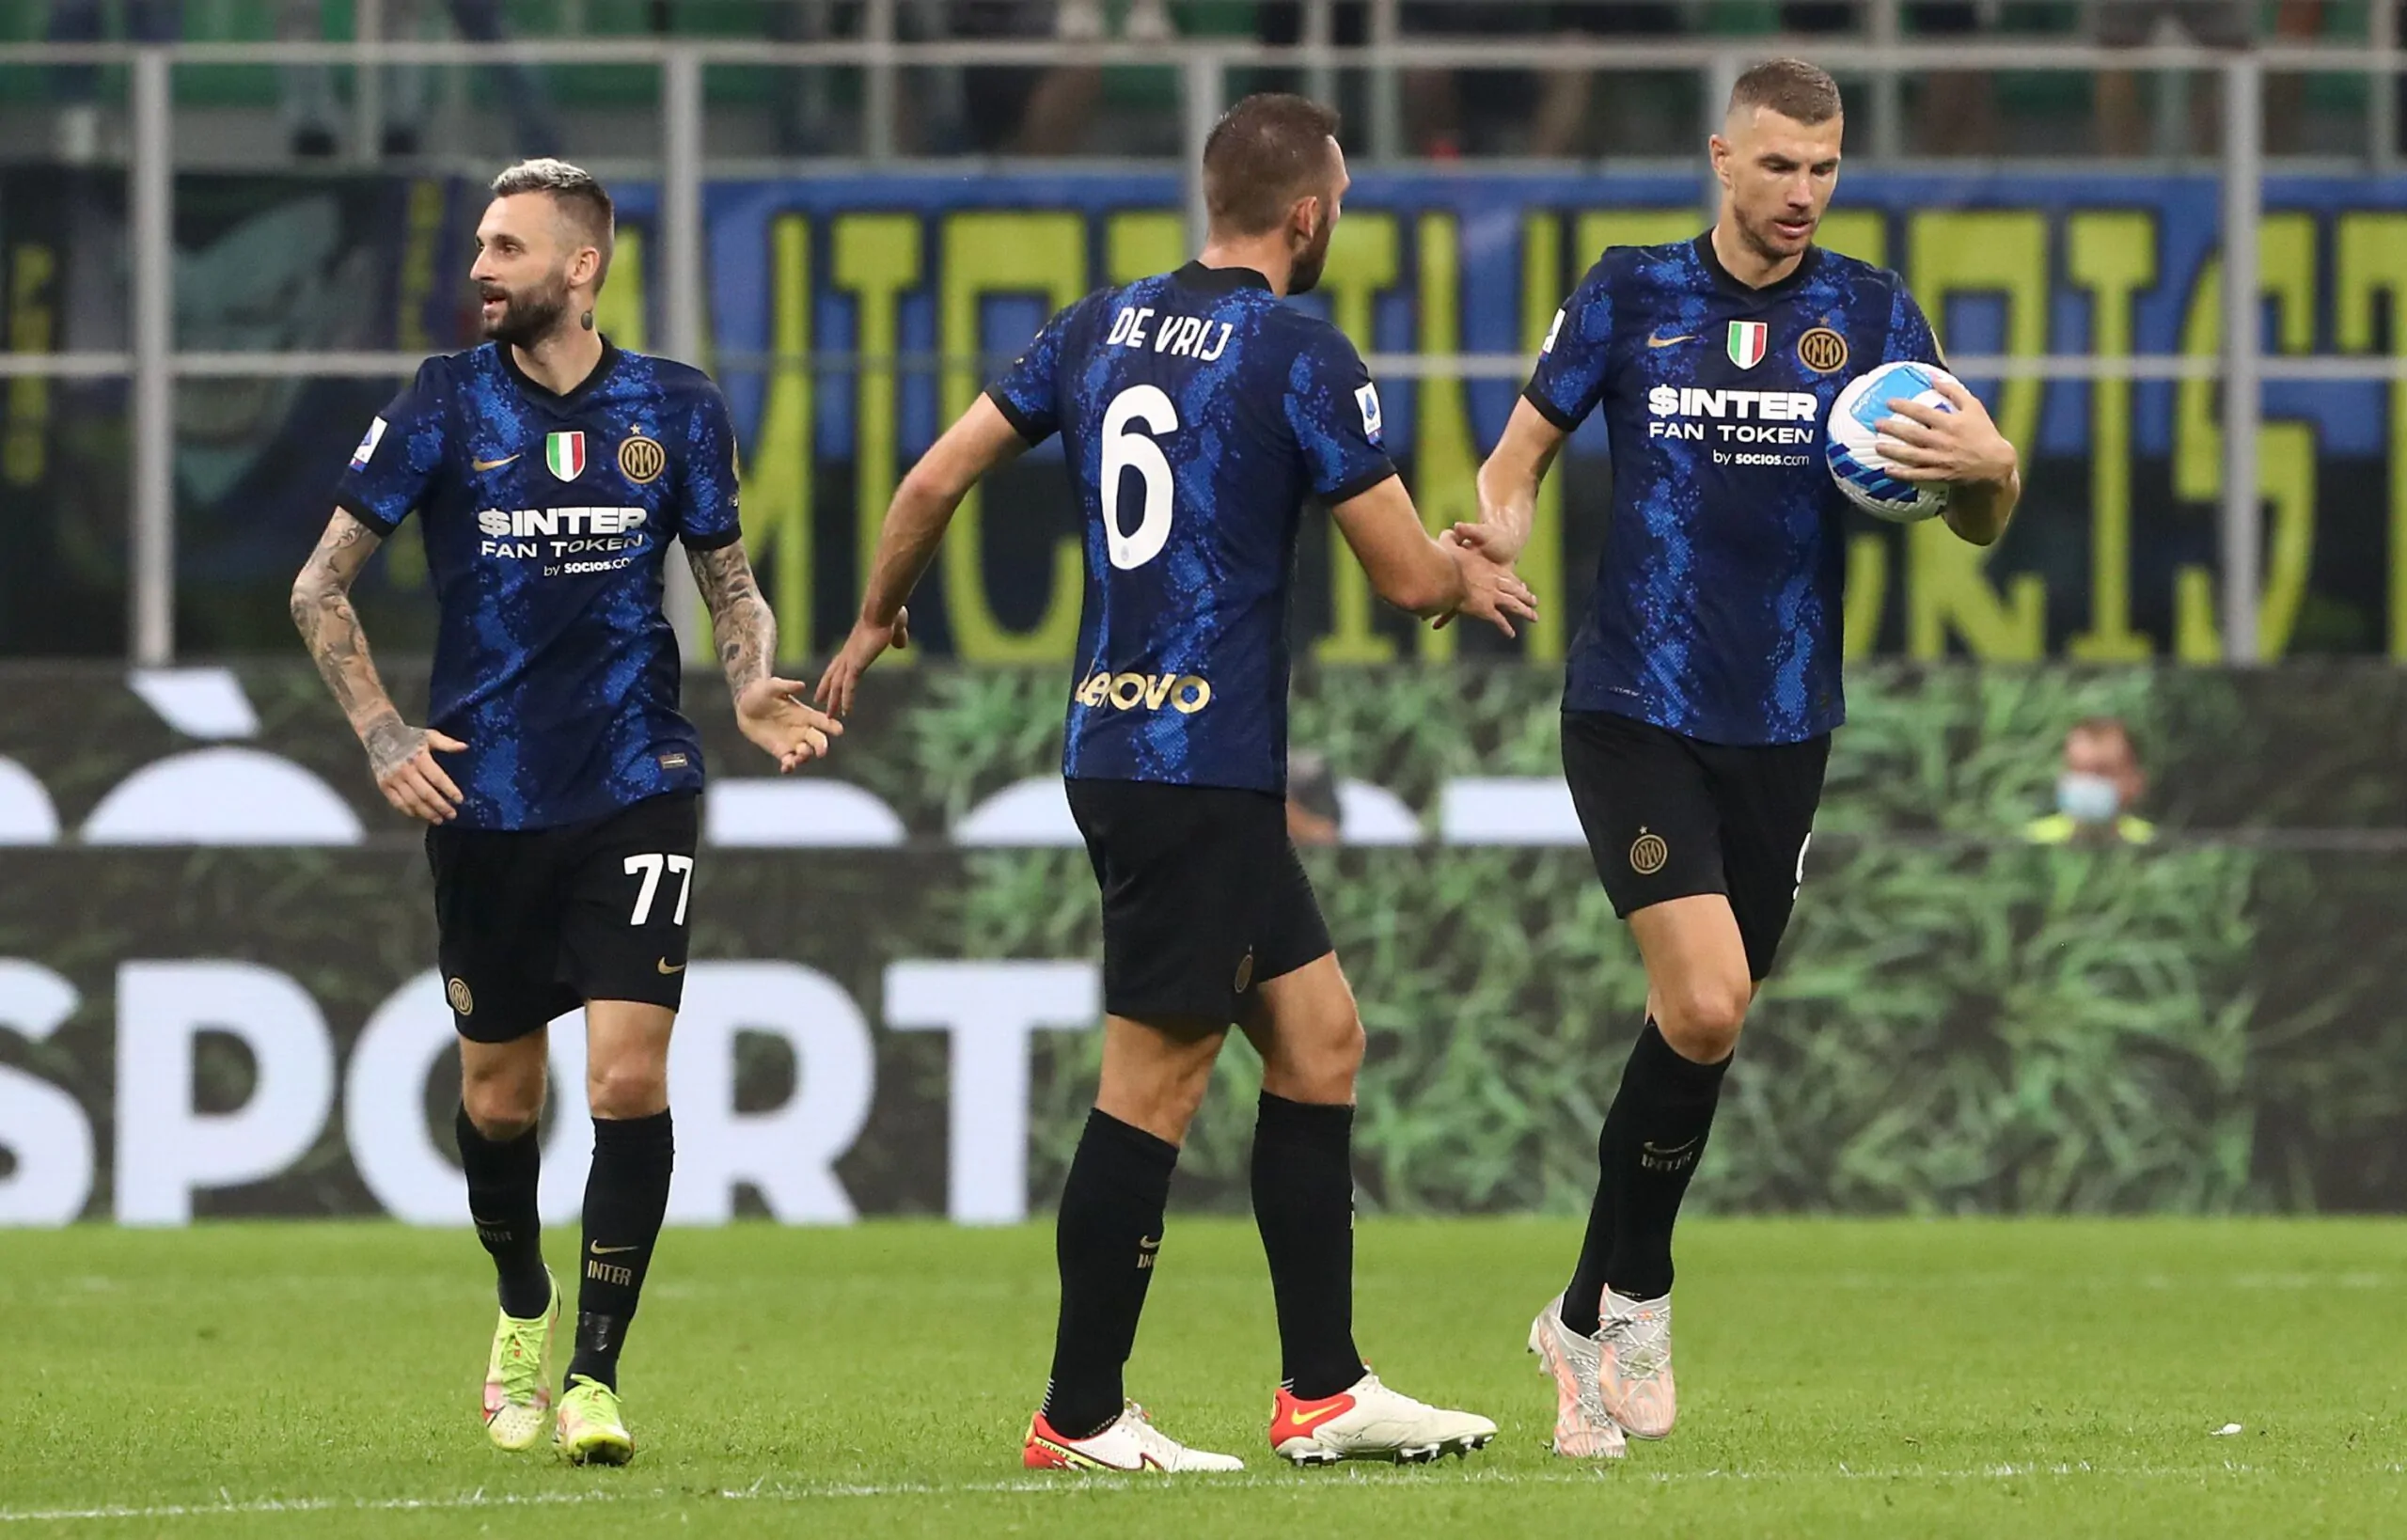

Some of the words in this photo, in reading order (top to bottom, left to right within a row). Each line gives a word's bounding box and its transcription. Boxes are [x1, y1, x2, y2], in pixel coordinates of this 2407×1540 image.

[1107, 307, 1154, 348] DE
[1156, 317, 1234, 362] VRIJ
[1648, 384, 1818, 421] $INTER
[1649, 422, 1705, 440] FAN
[1717, 425, 1815, 444] TOKEN
[1712, 449, 1732, 465] by
[1100, 384, 1179, 572] 6
[478, 507, 648, 539] $INTER
[481, 541, 537, 558] FAN
[550, 534, 643, 558] TOKEN
[543, 565, 560, 576] by
[564, 557, 637, 574] socios.co
[623, 853, 694, 926] 77
[588, 1260, 632, 1286] INTER
